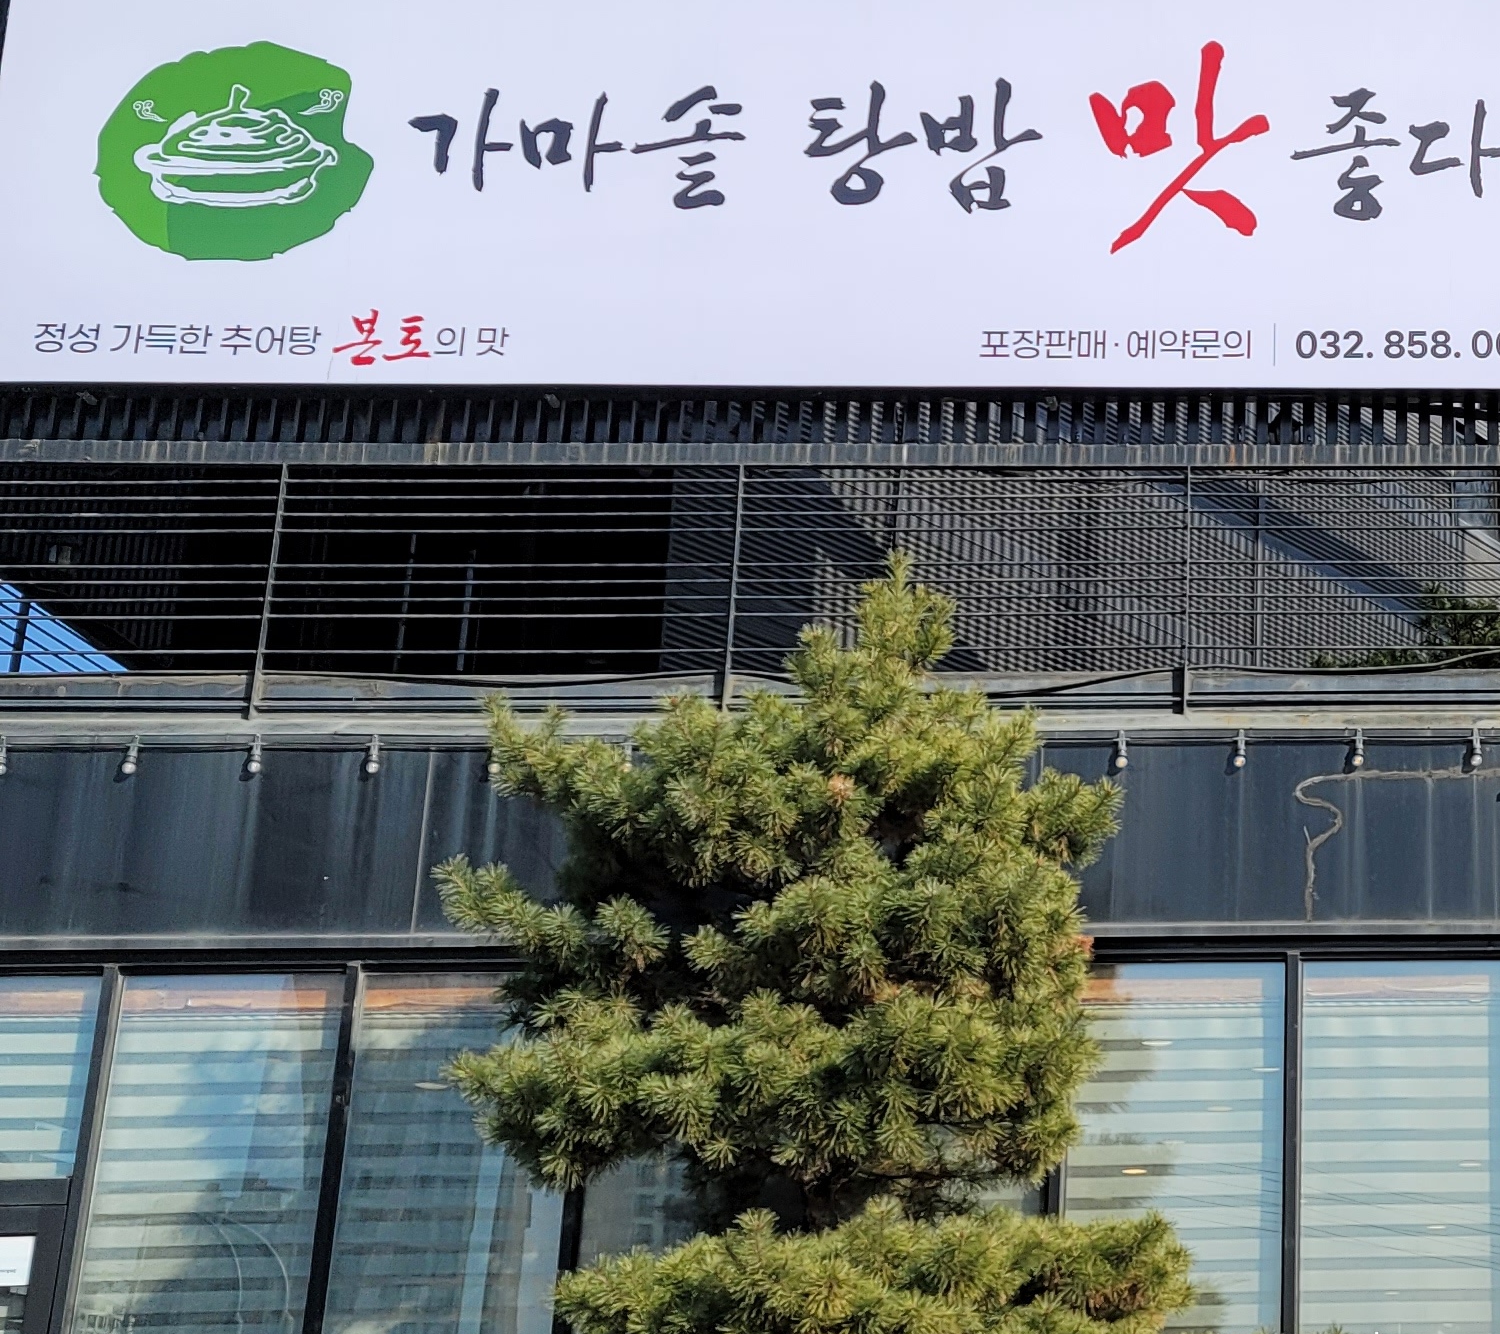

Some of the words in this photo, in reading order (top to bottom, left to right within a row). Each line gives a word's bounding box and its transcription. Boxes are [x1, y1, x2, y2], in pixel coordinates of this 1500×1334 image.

[409, 86, 746, 210] 가마솥
[804, 77, 1042, 214] 탕밥
[1089, 40, 1270, 254] 맛
[34, 322, 101, 354] 정성
[110, 324, 213, 355] 가득한
[220, 325, 322, 356] 추어탕
[333, 309, 466, 365] 본토의
[477, 327, 510, 356] 맛
